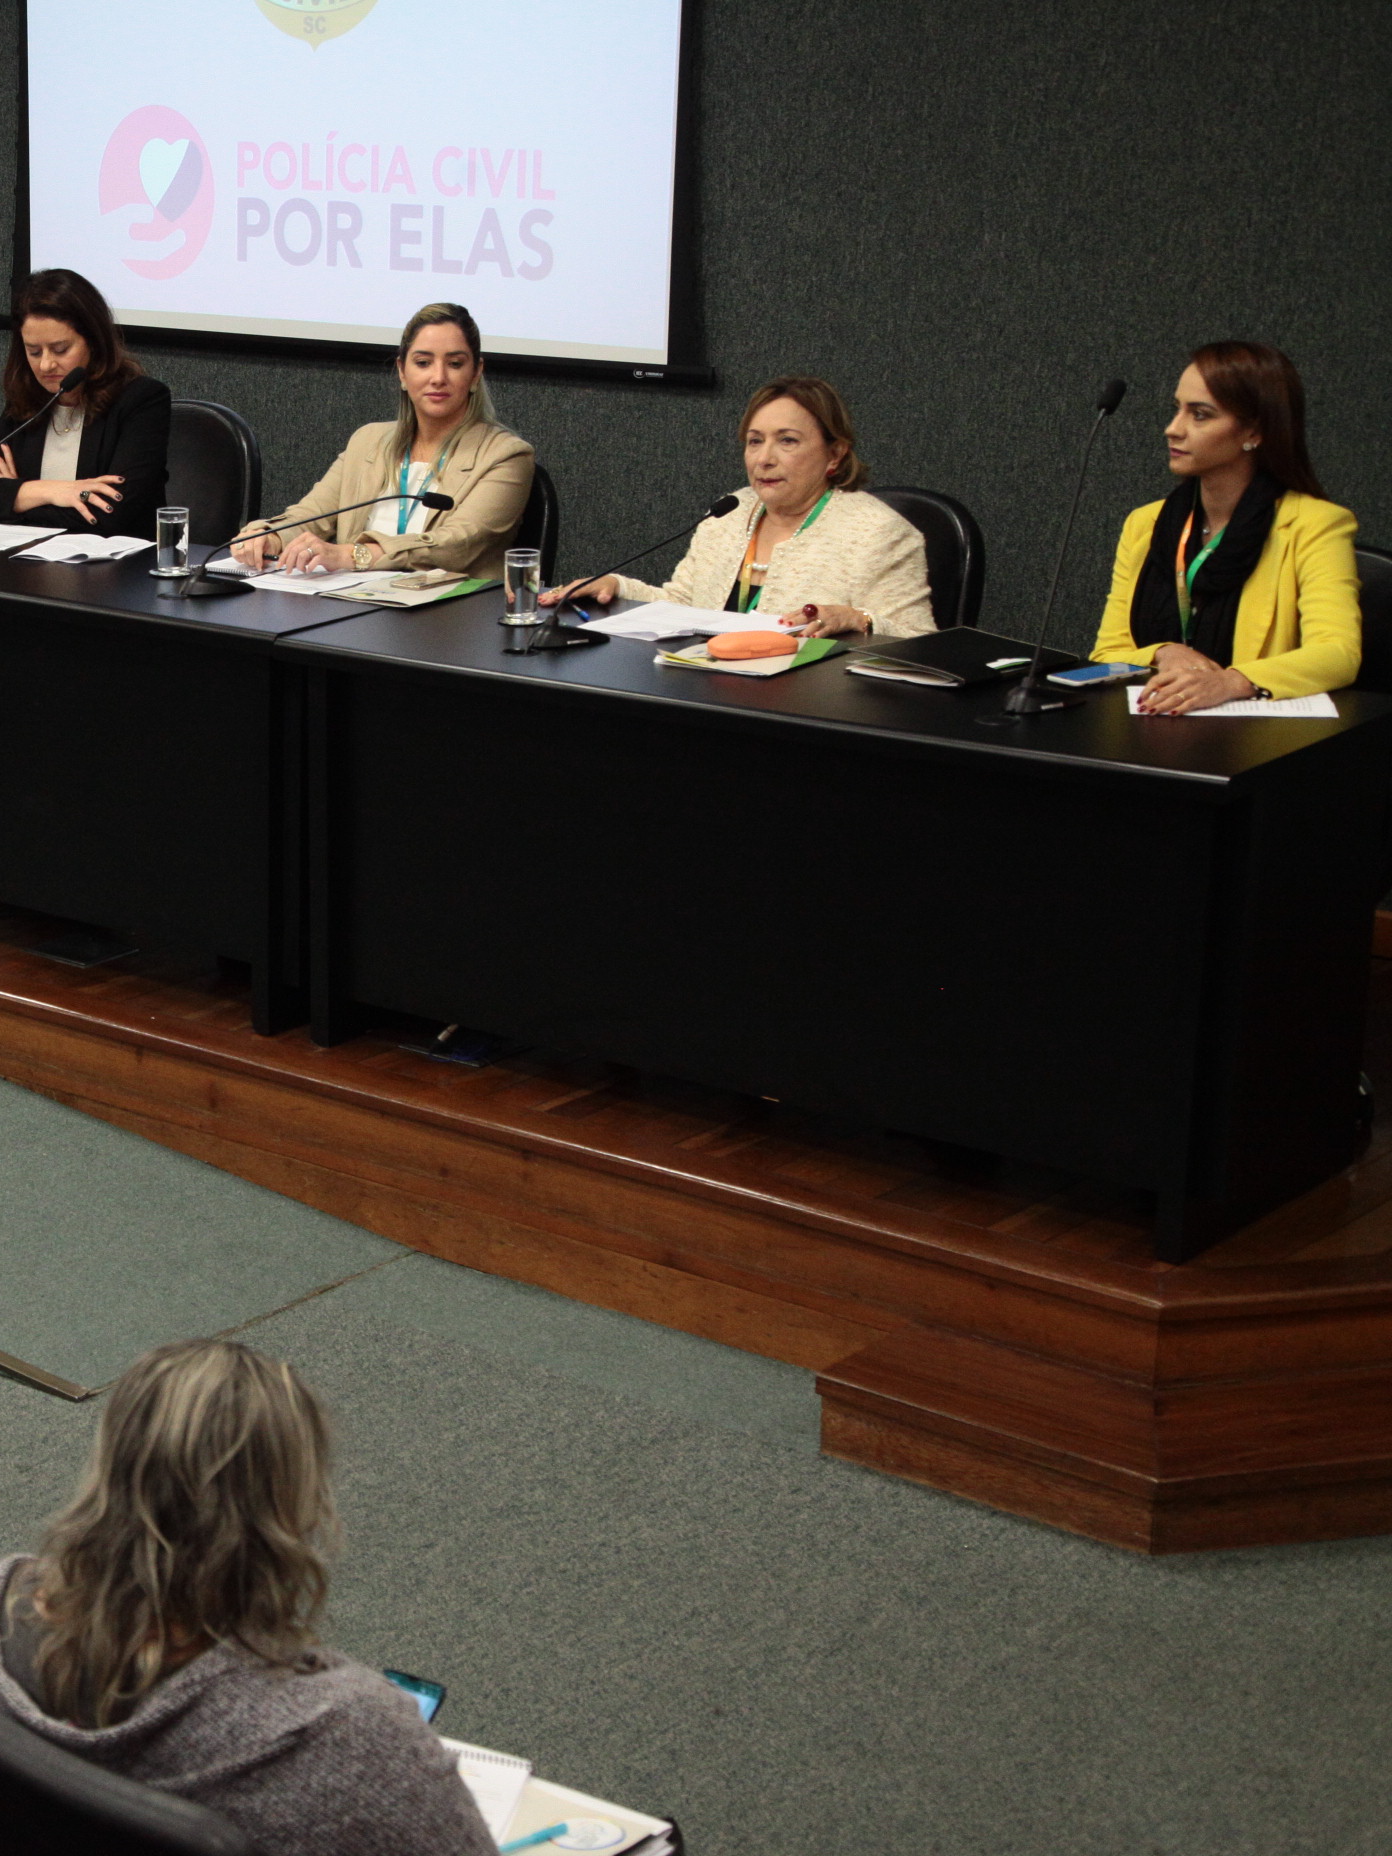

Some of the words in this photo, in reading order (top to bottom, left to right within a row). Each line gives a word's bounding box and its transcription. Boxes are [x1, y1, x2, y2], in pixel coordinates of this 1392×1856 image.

[303, 15, 326, 34] SC
[236, 130, 417, 195] POLÍCIA
[432, 146, 556, 200] CIVIL
[236, 197, 363, 269] POR
[389, 203, 555, 281] ELAS
